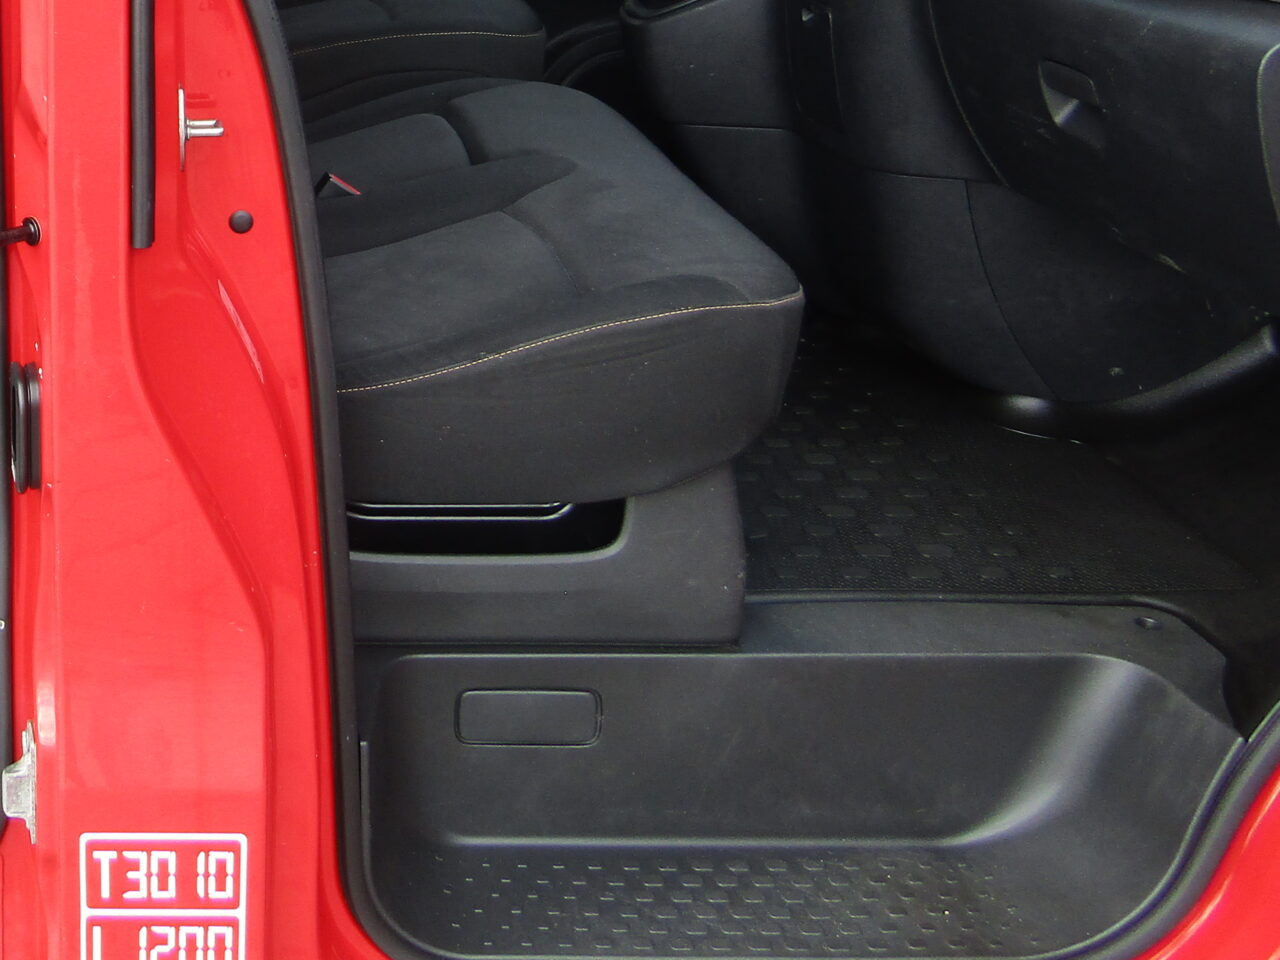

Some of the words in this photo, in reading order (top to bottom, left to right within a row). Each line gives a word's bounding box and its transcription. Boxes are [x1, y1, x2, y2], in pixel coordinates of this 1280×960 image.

[92, 850, 176, 899] T30
[196, 850, 234, 899] 10
[138, 925, 234, 960] 1200
